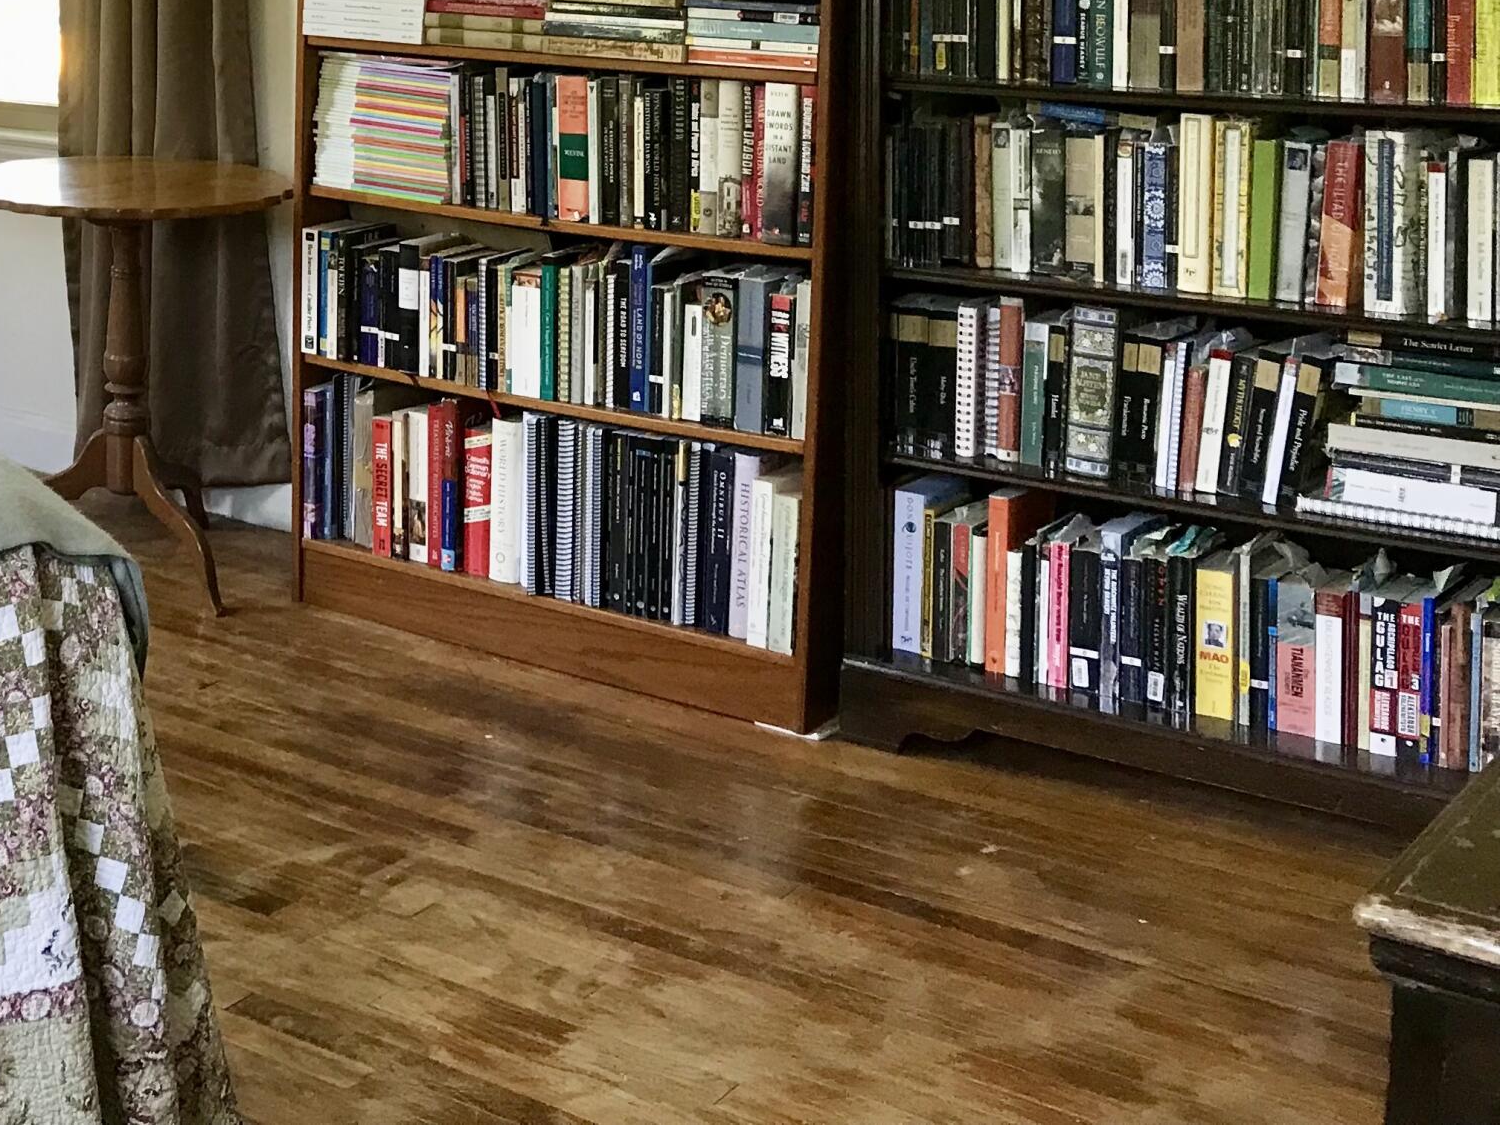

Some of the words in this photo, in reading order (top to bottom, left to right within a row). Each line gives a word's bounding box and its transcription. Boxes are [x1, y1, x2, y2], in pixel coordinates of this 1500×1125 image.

[1094, 14, 1107, 69] BEOWULF
[766, 110, 792, 119] DRAWN
[768, 156, 788, 165] LAND
[1334, 161, 1348, 184] THE
[1330, 187, 1347, 219] ILIAD
[337, 256, 346, 297] TOLKIEN
[620, 297, 628, 310] THE
[620, 310, 628, 328] ROAD
[635, 307, 644, 332] LAND
[620, 329, 627, 338] TO
[635, 332, 643, 345] OF
[1402, 337, 1419, 348] The
[1420, 339, 1448, 351] Scarlet
[1448, 342, 1474, 354] Letter
[619, 338, 627, 368] SERFDOM
[635, 346, 643, 370] HOPE
[769, 331, 790, 379] WITNESS
[717, 334, 734, 401] Democracy
[1049, 393, 1060, 419] Hamlet
[1232, 378, 1247, 431] MYTHOLOGY
[1296, 408, 1309, 427] Pride
[1294, 427, 1306, 440] and
[376, 442, 387, 460] THE
[498, 439, 509, 479] WORLD
[1287, 441, 1303, 472] Prejudice
[375, 462, 388, 498] SECRET
[717, 471, 727, 523] OMNIBUS
[905, 496, 915, 520] DON
[375, 500, 388, 527] TEAM
[497, 488, 508, 535] HISTORY
[736, 482, 751, 564] HISTORICAL
[716, 527, 726, 539] II
[1109, 569, 1118, 581] THE
[734, 569, 746, 609] ATLAS
[1176, 593, 1189, 623] WEALTH
[1376, 611, 1396, 624] THE
[1401, 614, 1421, 627] THE
[1176, 623, 1185, 633] OF
[1175, 634, 1188, 666] NATIONS
[1199, 650, 1230, 664] MAO
[1374, 622, 1387, 689] GULAG
[1386, 622, 1397, 670] ARCHIPELAGO
[1401, 624, 1411, 691] GULAG
[1290, 646, 1304, 698] TIANANMEN
[1410, 677, 1420, 691] 3
